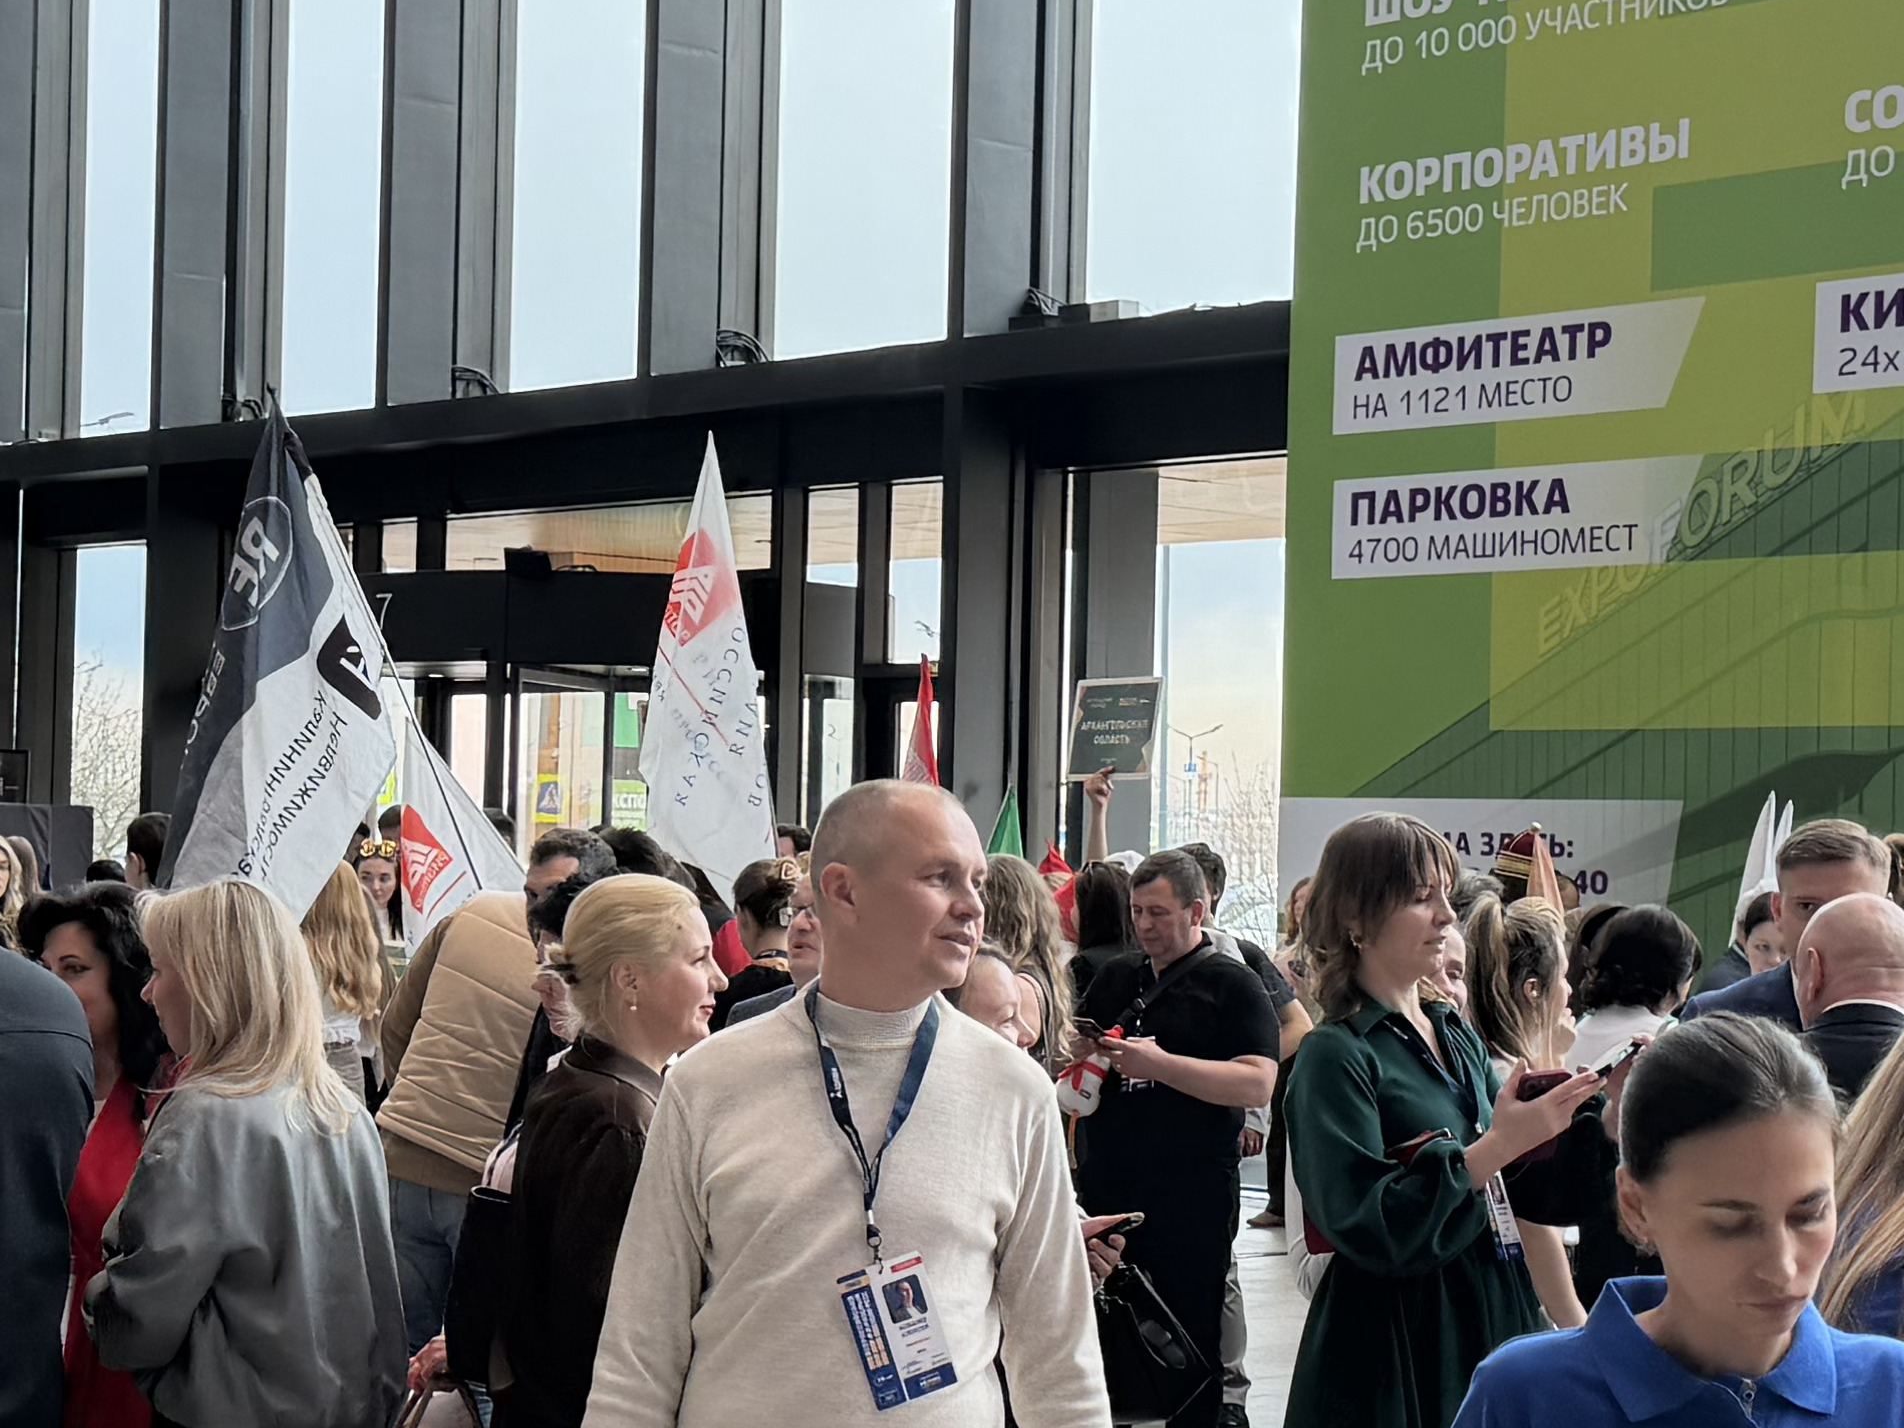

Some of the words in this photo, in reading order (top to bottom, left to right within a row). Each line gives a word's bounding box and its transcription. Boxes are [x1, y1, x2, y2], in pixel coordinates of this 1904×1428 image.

[1361, 34, 1405, 77] ДО
[1414, 24, 1450, 62] 10
[1455, 13, 1518, 56] 000
[1357, 117, 1693, 206] КОРПОРАТИВЫ
[1840, 142, 1899, 192] ДО
[1354, 213, 1399, 254] ДО
[1403, 202, 1485, 245] 6500
[1491, 182, 1629, 232] ЧЕЛОВЕК
[1353, 320, 1614, 383] АМФИТЕАТР
[1350, 391, 1390, 420] НА
[1397, 382, 1471, 416] 1121
[1476, 374, 1573, 411] МЕСТО
[1348, 477, 1572, 527] ПАРКОВКА
[1347, 534, 1420, 566] 4700
[1426, 523, 1639, 563] МАШИНОМЕСТ
